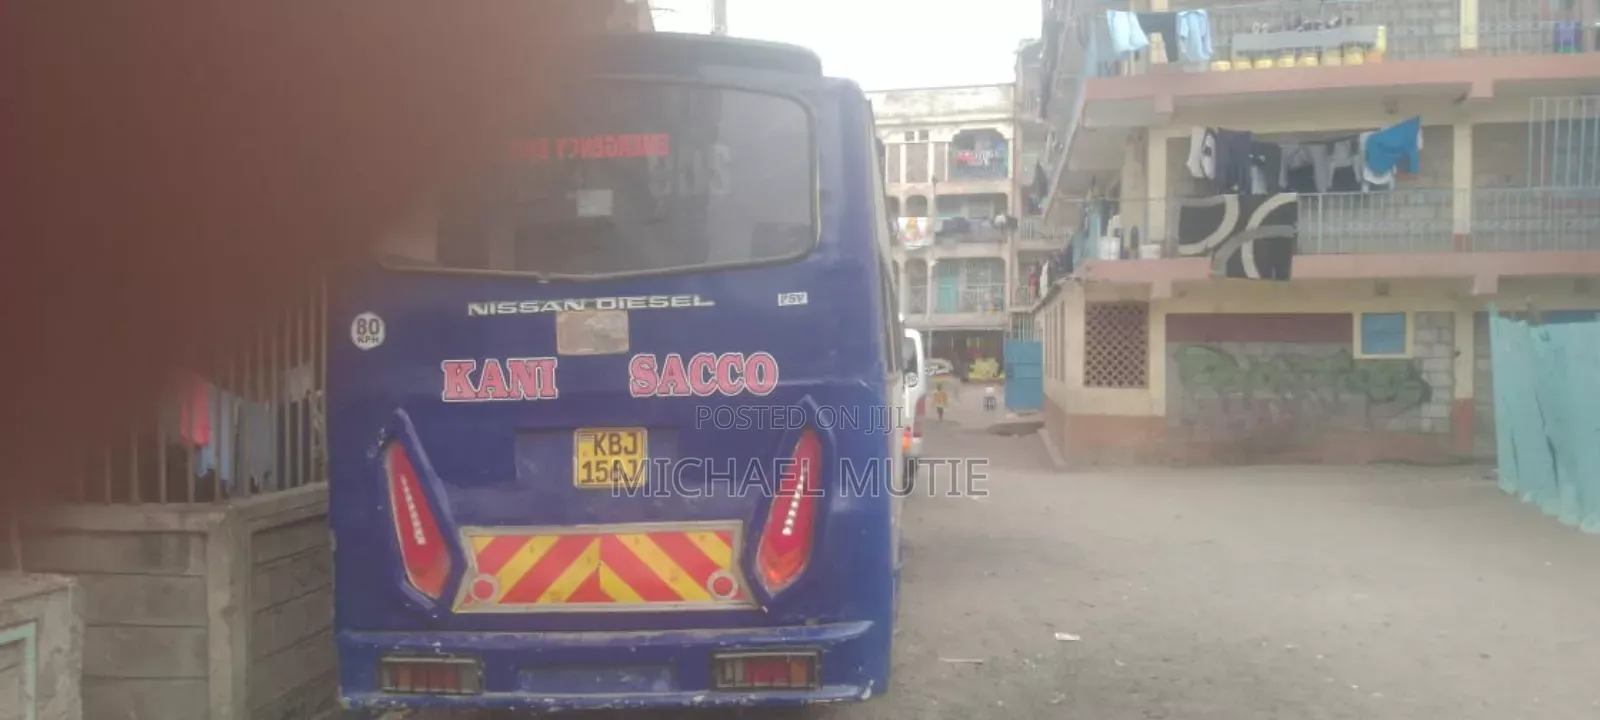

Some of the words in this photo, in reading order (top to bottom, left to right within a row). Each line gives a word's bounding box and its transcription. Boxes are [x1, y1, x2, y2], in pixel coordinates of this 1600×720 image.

[467, 298, 585, 317] NISSAN
[597, 294, 716, 310] DIESEL
[356, 317, 380, 335] 80
[357, 334, 380, 344] KPH
[441, 357, 559, 402] KANI
[628, 351, 779, 397] SACCO
[593, 431, 638, 456] KBJ
